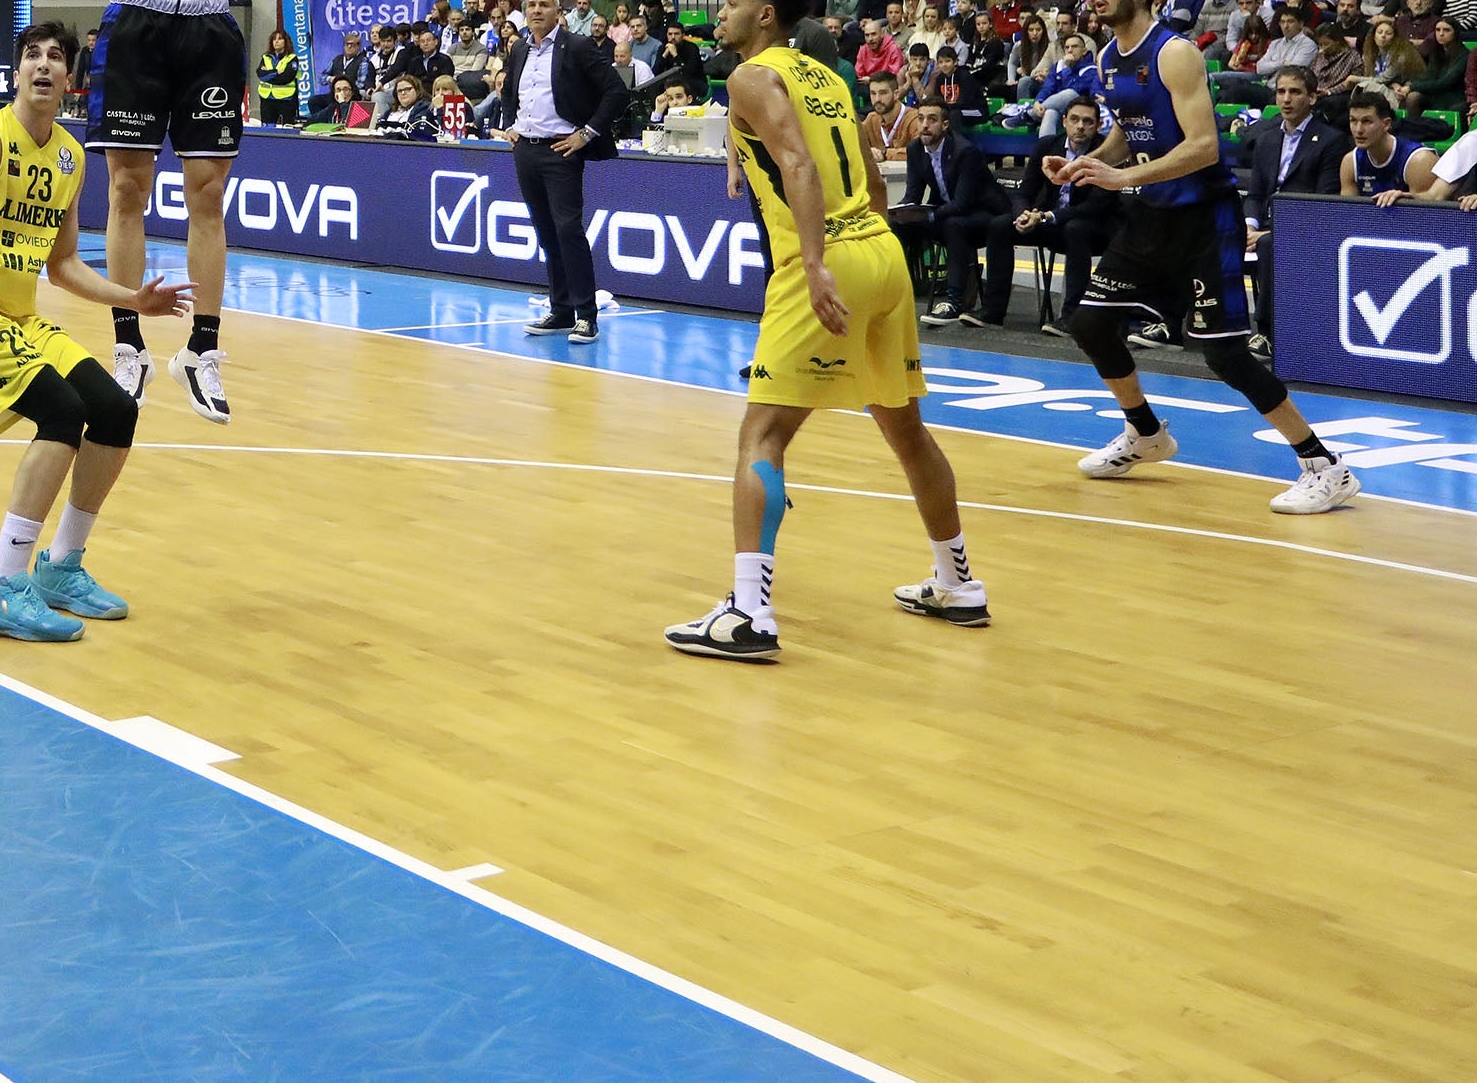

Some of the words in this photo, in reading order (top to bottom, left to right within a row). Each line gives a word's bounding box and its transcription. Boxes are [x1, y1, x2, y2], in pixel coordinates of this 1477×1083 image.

[106, 110, 139, 119] CASTILLA
[192, 110, 236, 120] LEXUS
[443, 101, 466, 130] 55
[111, 129, 141, 138] GIVOVA
[830, 125, 854, 198] 1
[26, 164, 53, 203] 23
